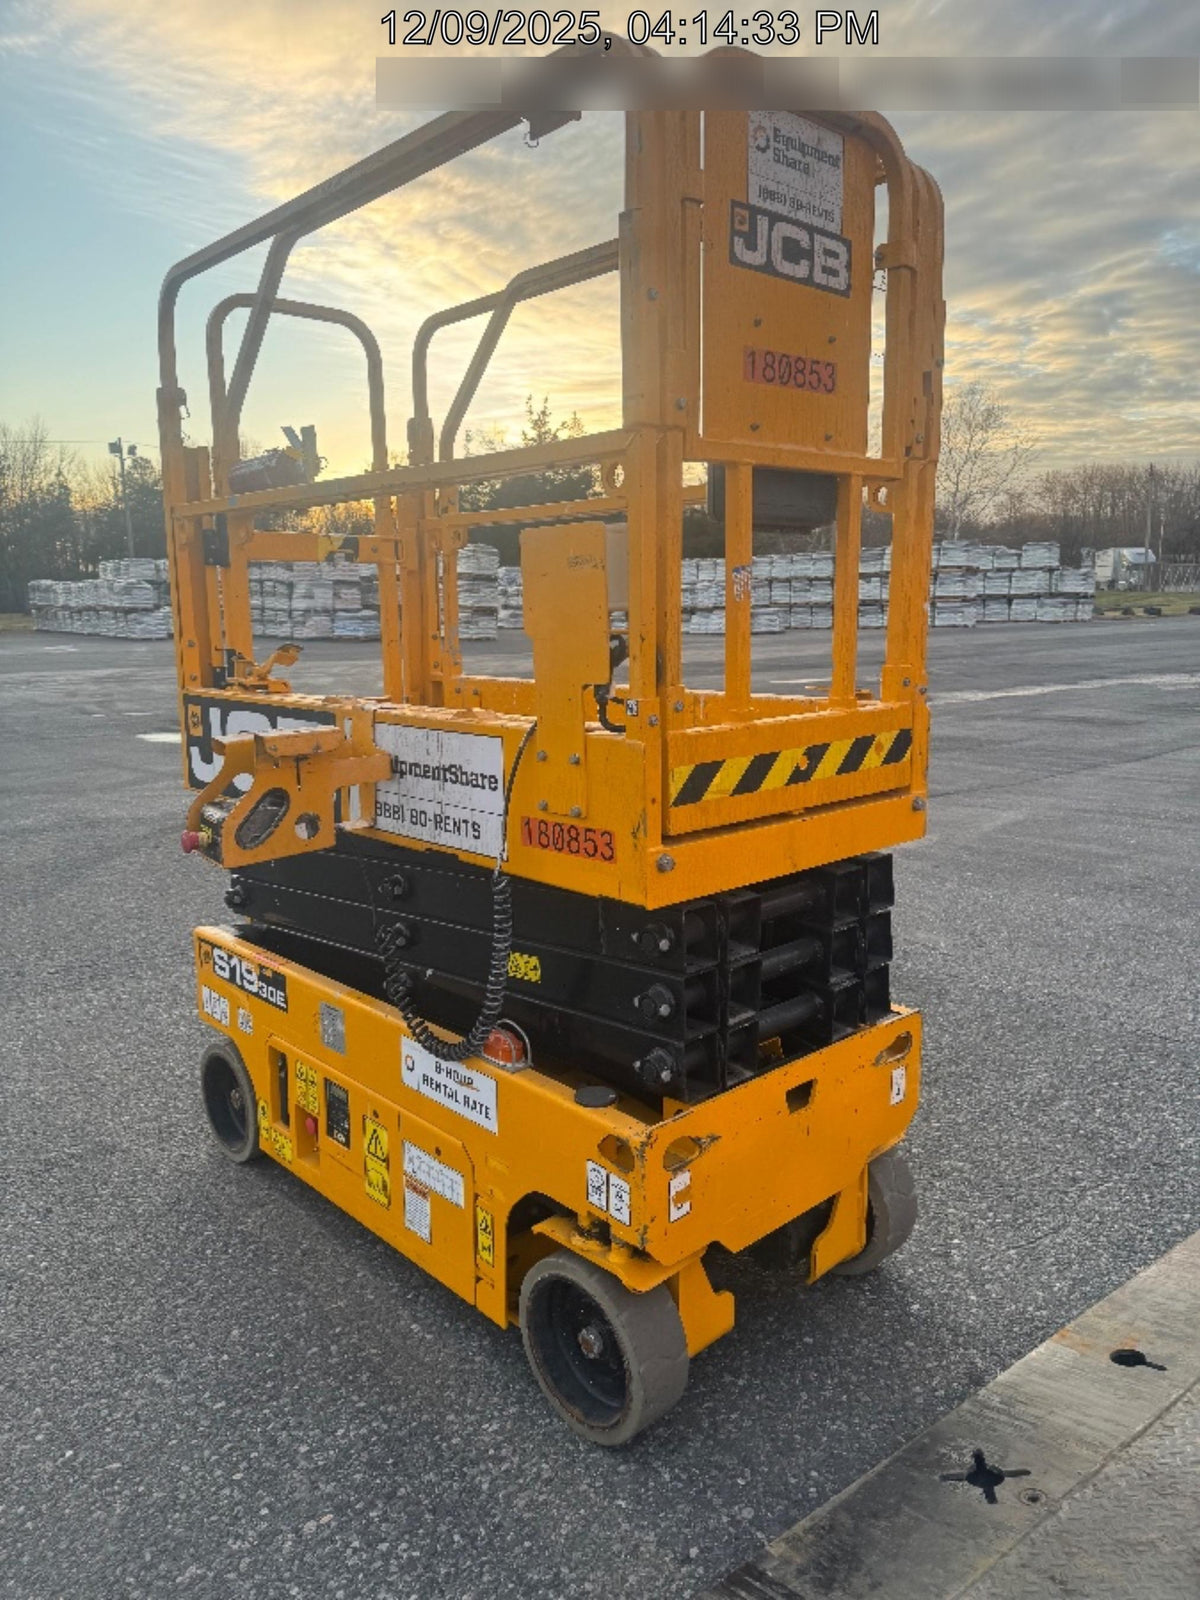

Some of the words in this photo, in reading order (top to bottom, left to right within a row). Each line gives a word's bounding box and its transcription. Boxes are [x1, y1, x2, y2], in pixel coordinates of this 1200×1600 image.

[773, 127, 841, 169] Equipment
[773, 147, 810, 175] Share
[733, 214, 850, 291] JCB
[745, 350, 836, 394] 180853
[391, 755, 499, 792] ipmentShare
[524, 817, 615, 861] 180853
[422, 1073, 461, 1105] RENTAL
[463, 1095, 492, 1121] RATE
